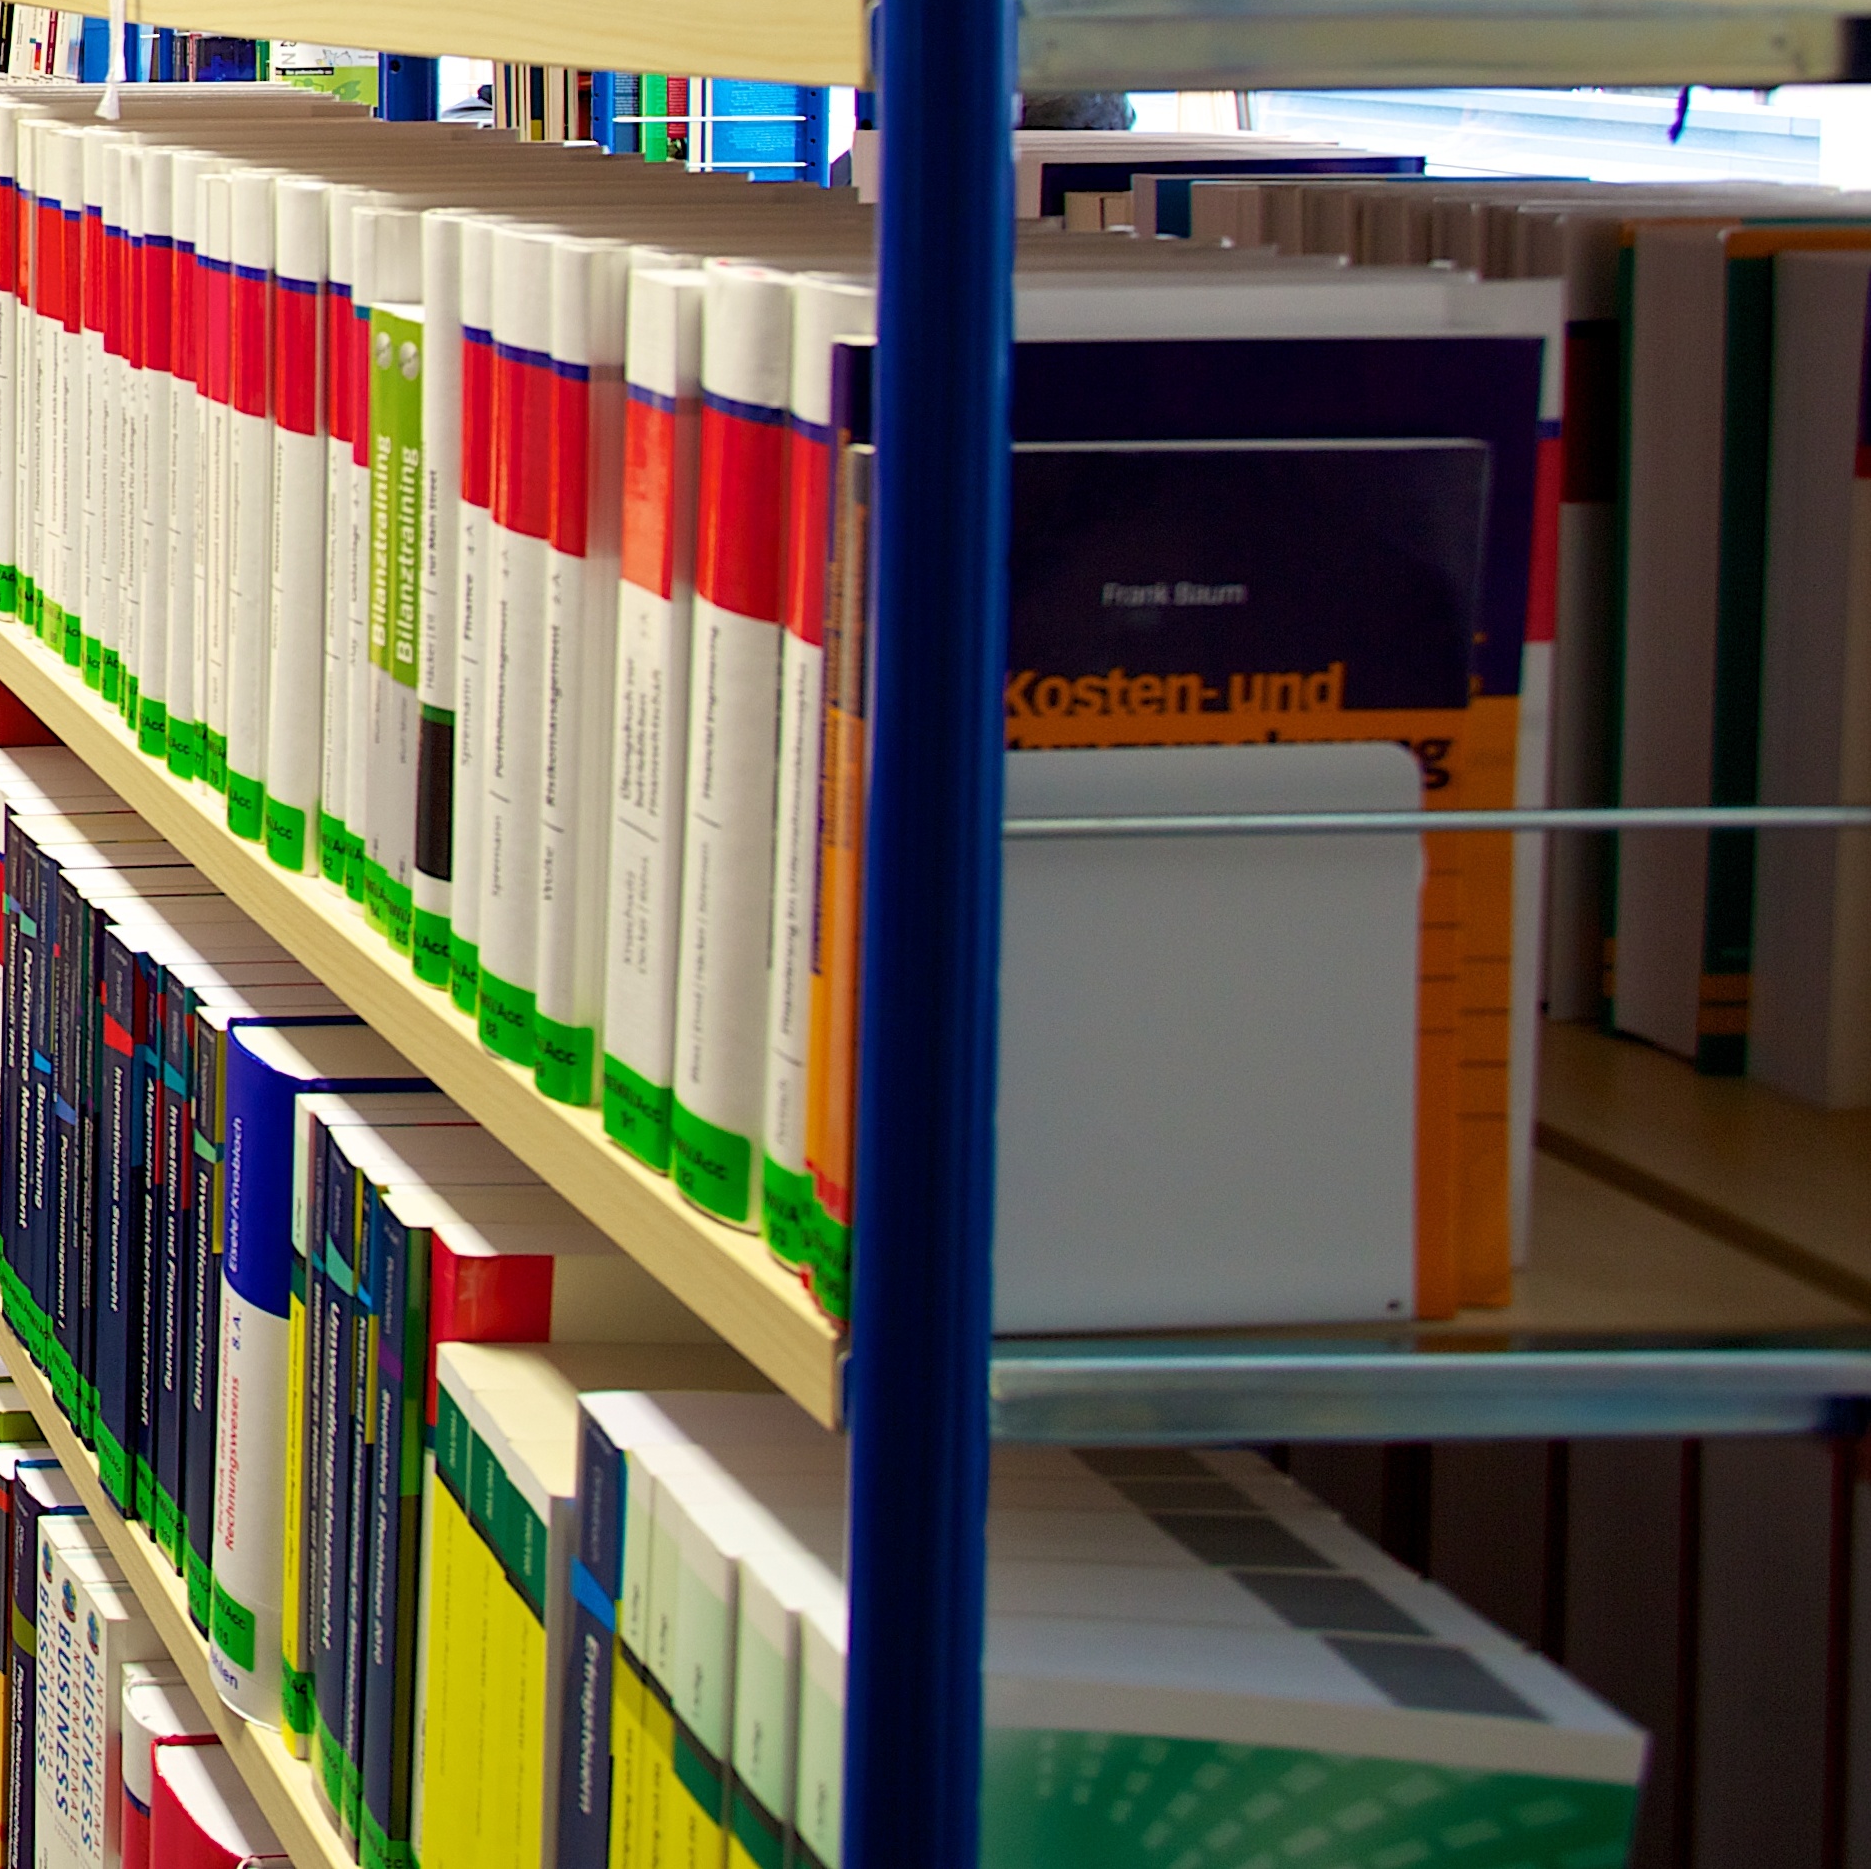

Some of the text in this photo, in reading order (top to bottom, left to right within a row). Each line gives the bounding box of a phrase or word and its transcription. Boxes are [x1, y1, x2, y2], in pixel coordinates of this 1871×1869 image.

[370, 431, 393, 650] Bilanztraining
[394, 444, 418, 668] Bilanztraining
[1230, 661, 1347, 713] und
[17, 947, 33, 1229] Performance Measurement
[227, 1116, 244, 1274] Eisele/Knobloch
[36, 1581, 50, 1776] BUSINESS
[47, 1599, 58, 1791] INTERNATIONAL
[56, 1620, 72, 1817] BUSINESS
[70, 1638, 82, 1826] INTERNATIONAL
[80, 1653, 95, 1853] BUSINESS
[94, 1671, 104, 1862] INTERNATIONAL
